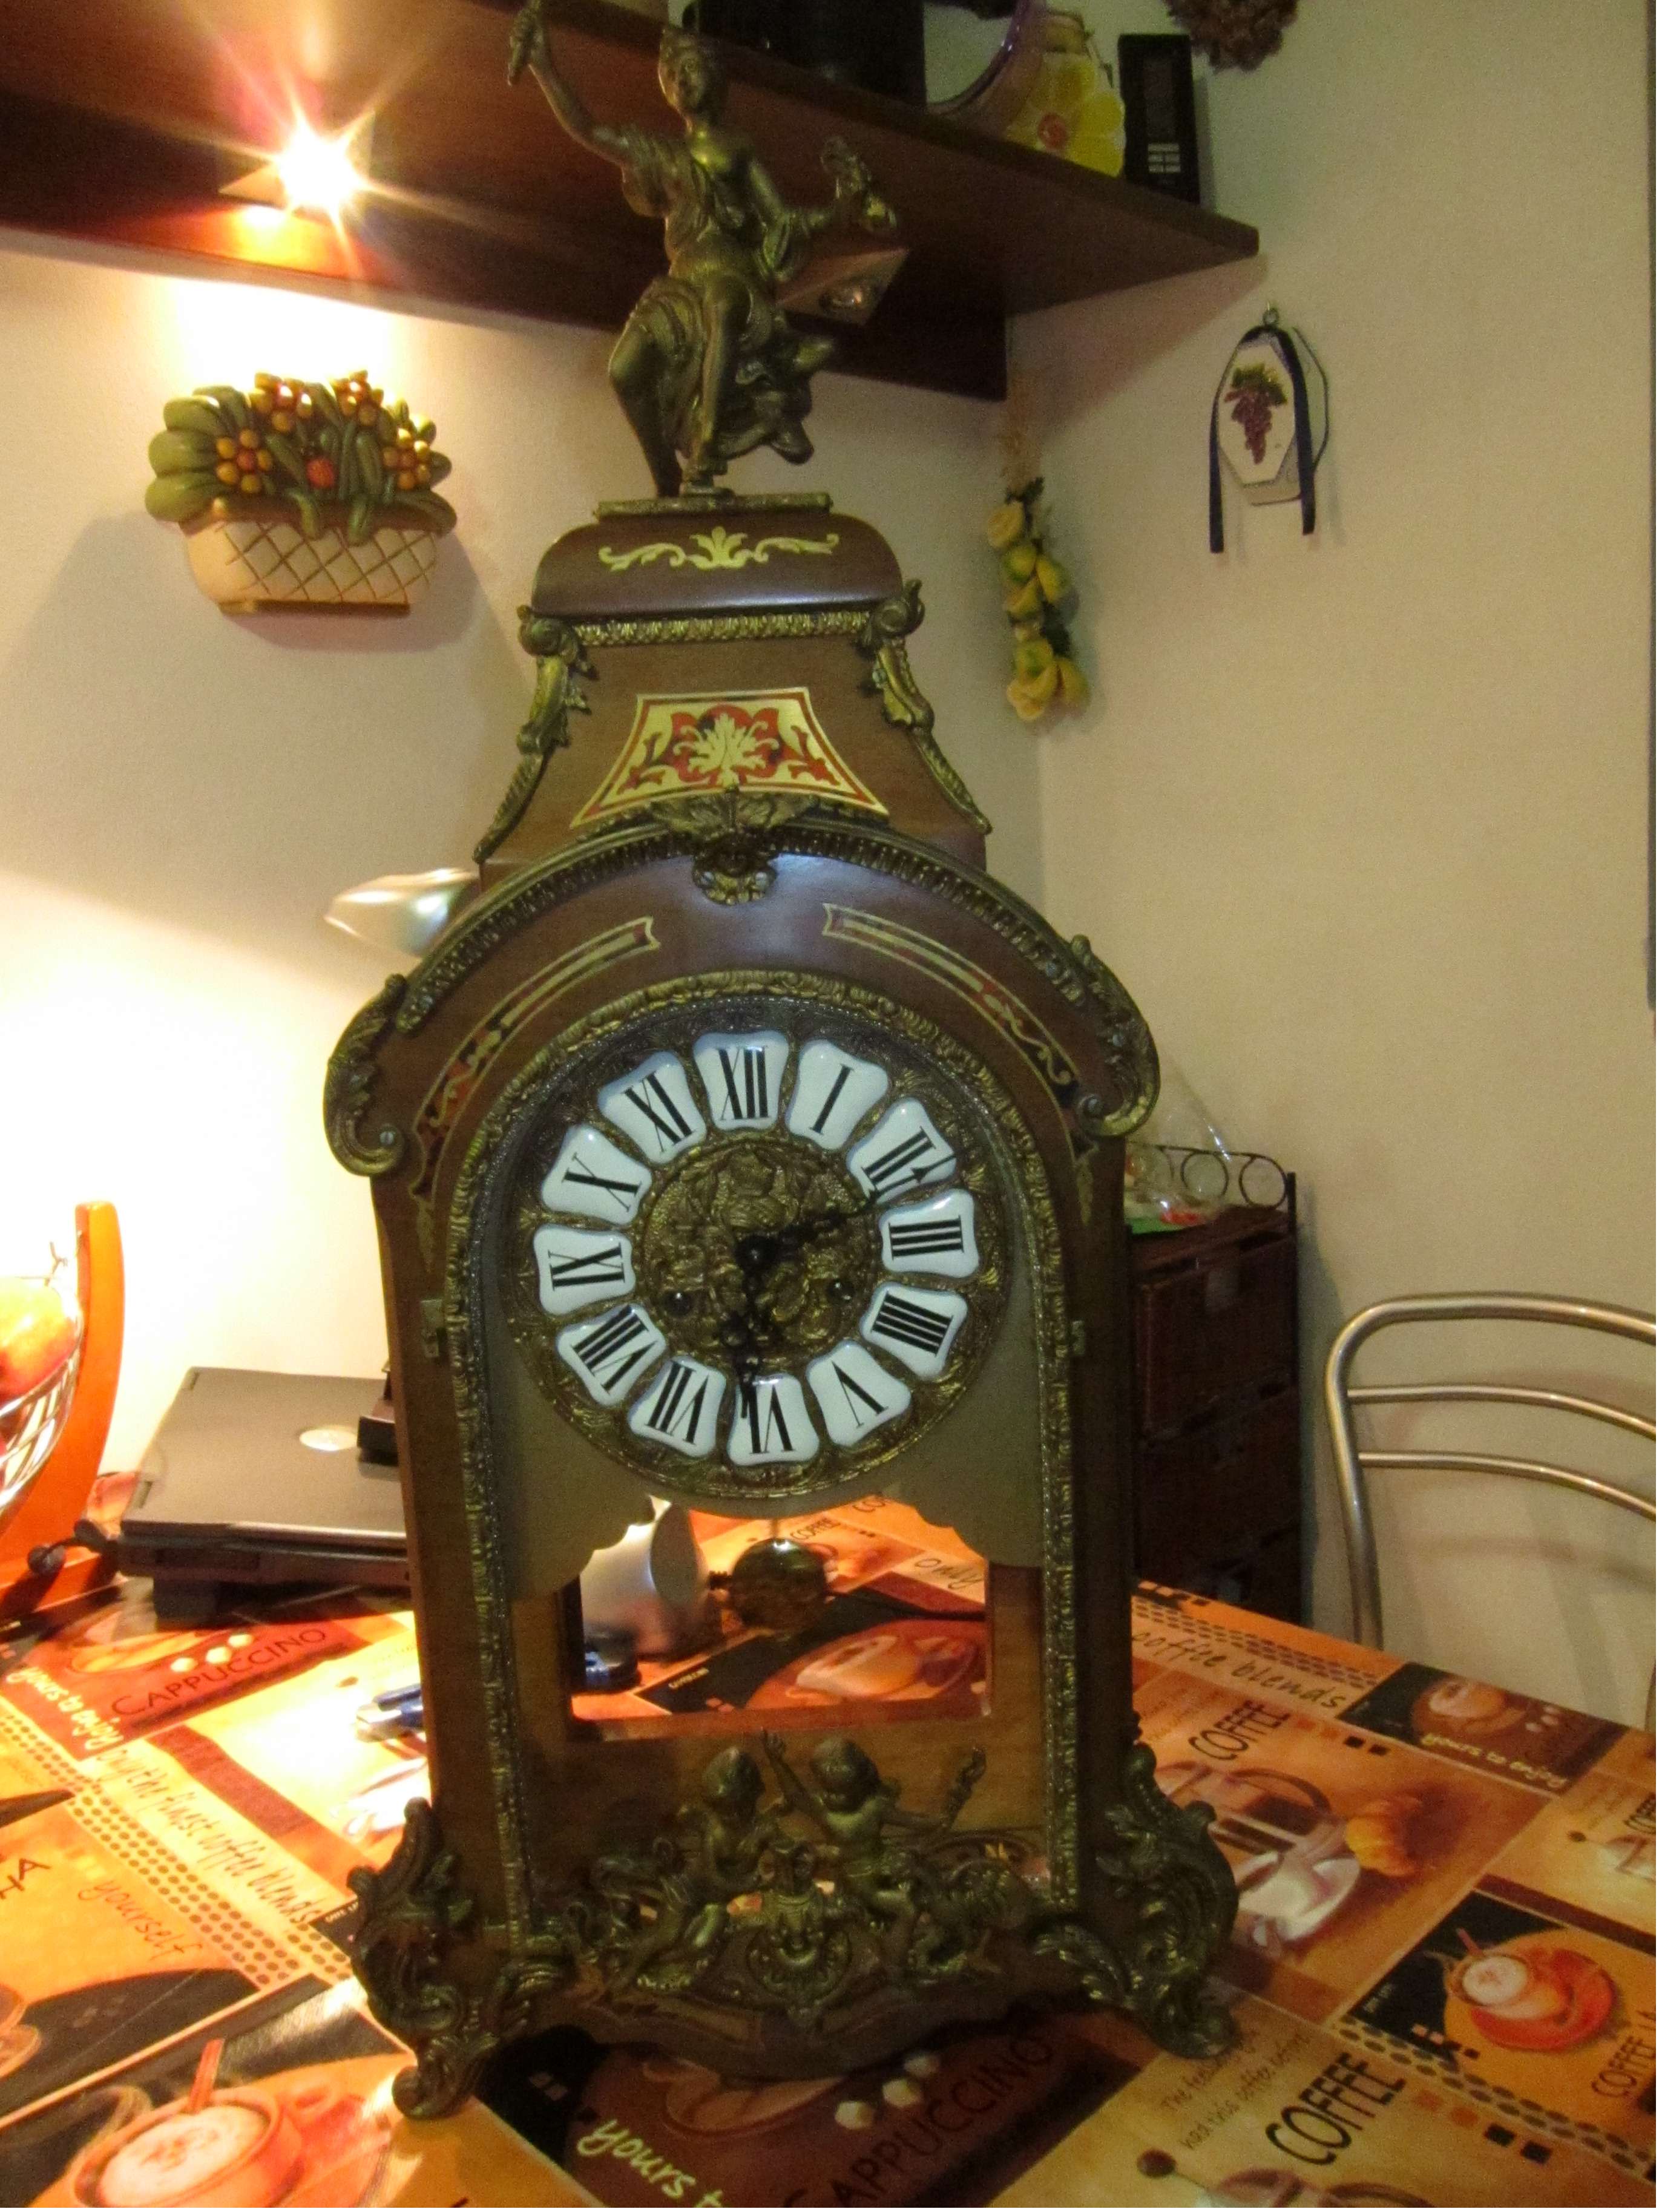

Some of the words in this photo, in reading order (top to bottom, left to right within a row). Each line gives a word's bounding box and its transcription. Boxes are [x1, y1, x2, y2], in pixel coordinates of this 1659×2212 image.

[624, 1072, 697, 1154] XI
[717, 1046, 770, 1120] XII
[809, 1064, 854, 1135] I
[562, 1152, 642, 1212] X
[861, 1125, 937, 1194] II
[547, 1242, 625, 1291] IX
[887, 1215, 965, 1260] III
[573, 1305, 659, 1394] VIII
[870, 1291, 954, 1356] IIII
[646, 1362, 711, 1445] VII
[747, 1383, 797, 1454] VI
[832, 1362, 889, 1428] V
[111, 1627, 327, 1715] CAPPUCCINO
[1132, 1632, 1227, 1667] coffee
[1231, 1660, 1346, 1708] blends
[1188, 1699, 1292, 1761] COFFEE
[78, 1880, 203, 1961] yourself
[1265, 2052, 1407, 2165] COFFEE
[577, 2119, 696, 2199] yours
